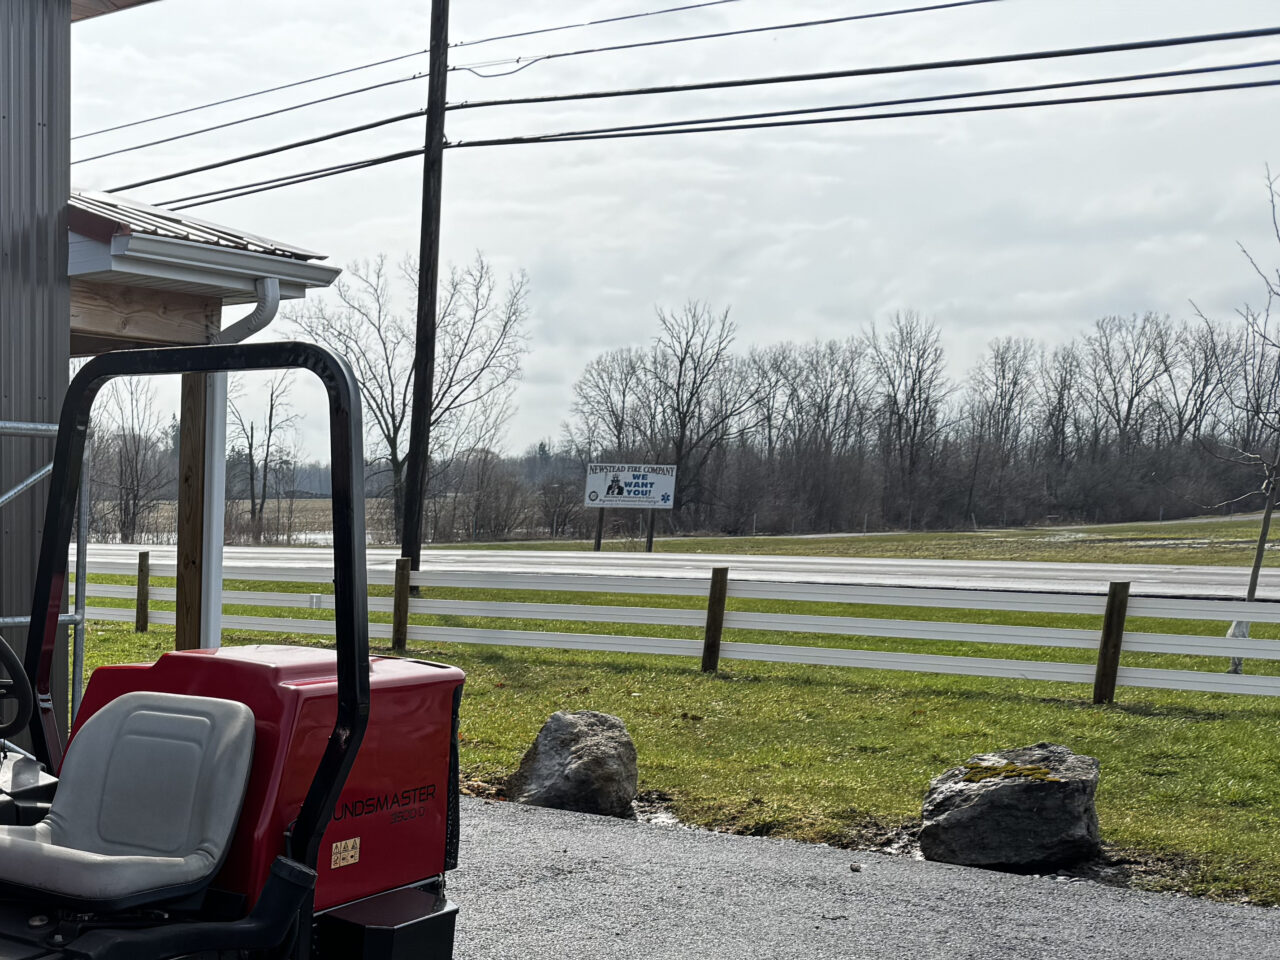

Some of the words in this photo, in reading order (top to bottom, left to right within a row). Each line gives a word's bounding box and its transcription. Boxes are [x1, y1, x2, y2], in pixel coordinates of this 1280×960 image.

[589, 465, 625, 475] NEWSTEAD
[643, 466, 675, 477] COMPANY
[624, 481, 655, 489] WANT
[626, 489, 651, 497] YOU!
[333, 784, 436, 821] UNDSMASTER
